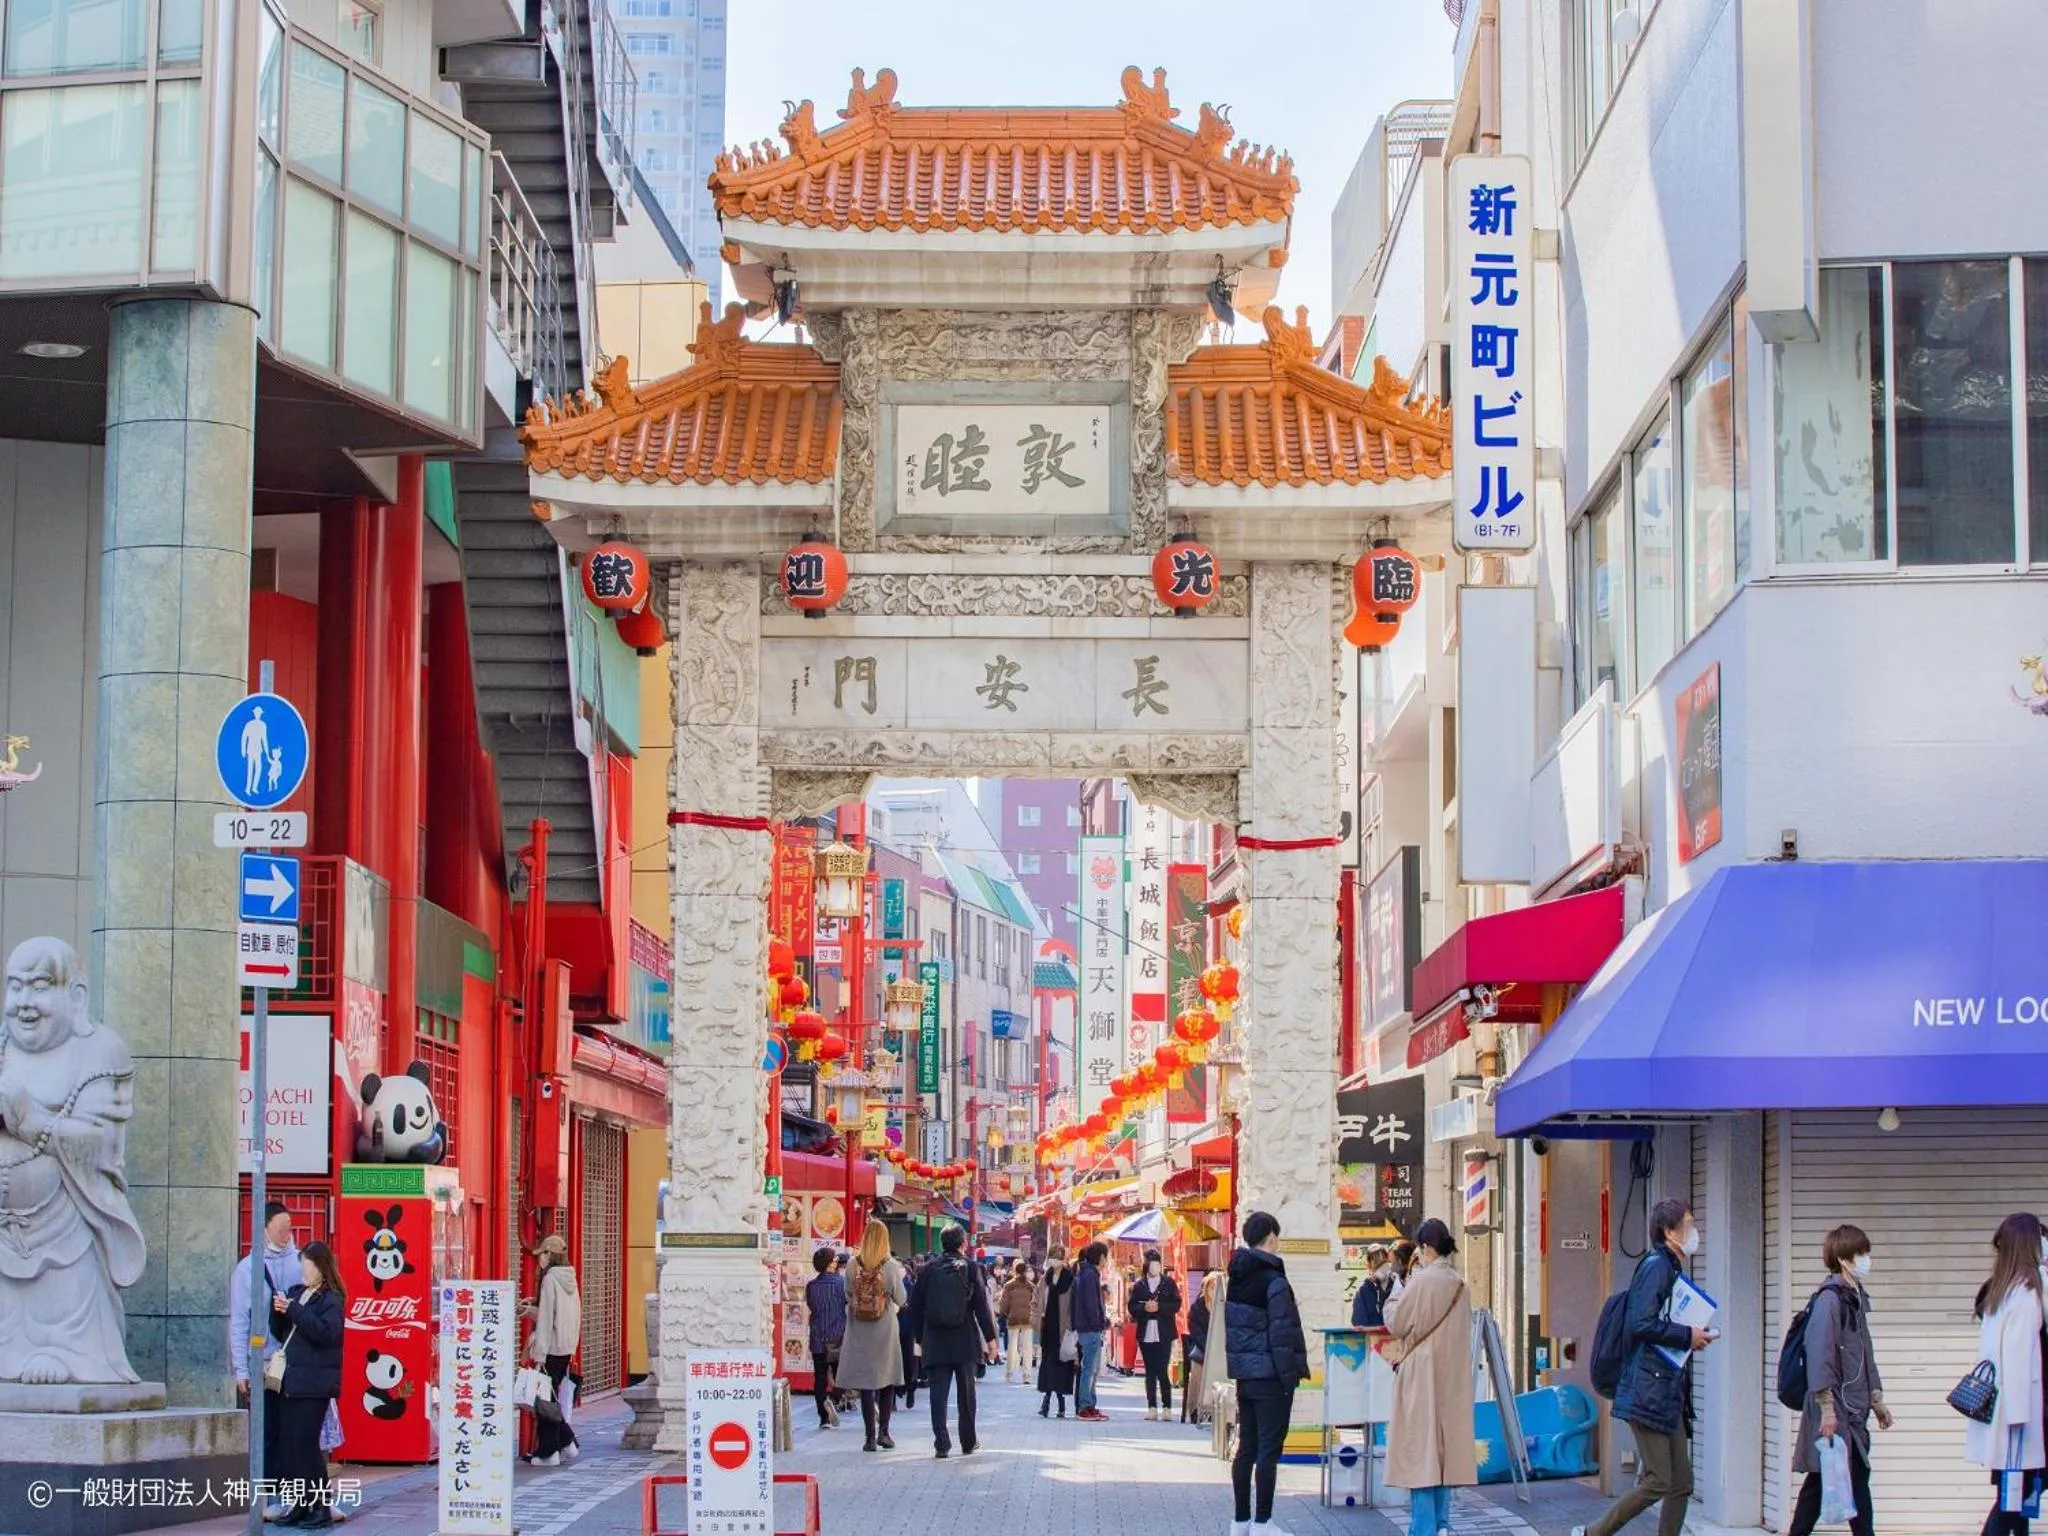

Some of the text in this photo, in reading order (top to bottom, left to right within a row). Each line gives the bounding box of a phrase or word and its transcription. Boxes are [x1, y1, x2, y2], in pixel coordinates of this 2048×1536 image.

[1468, 184, 1525, 519] 新元町ビル
[786, 552, 826, 598] 迎
[1168, 550, 1215, 598] 光
[1370, 556, 1415, 603] 臨
[1140, 846, 1161, 979] 長城飯店
[1913, 997, 1986, 1027] NEW
[240, 1088, 313, 1104] OACHI
[1380, 1187, 1412, 1198] STEAK
[1381, 1198, 1413, 1208] SUSHI
[481, 1289, 500, 1437] 迷惑となるような
[690, 1361, 767, 1378] 車両通行禁止
[454, 1288, 474, 1492] 客引きにご注意ください
